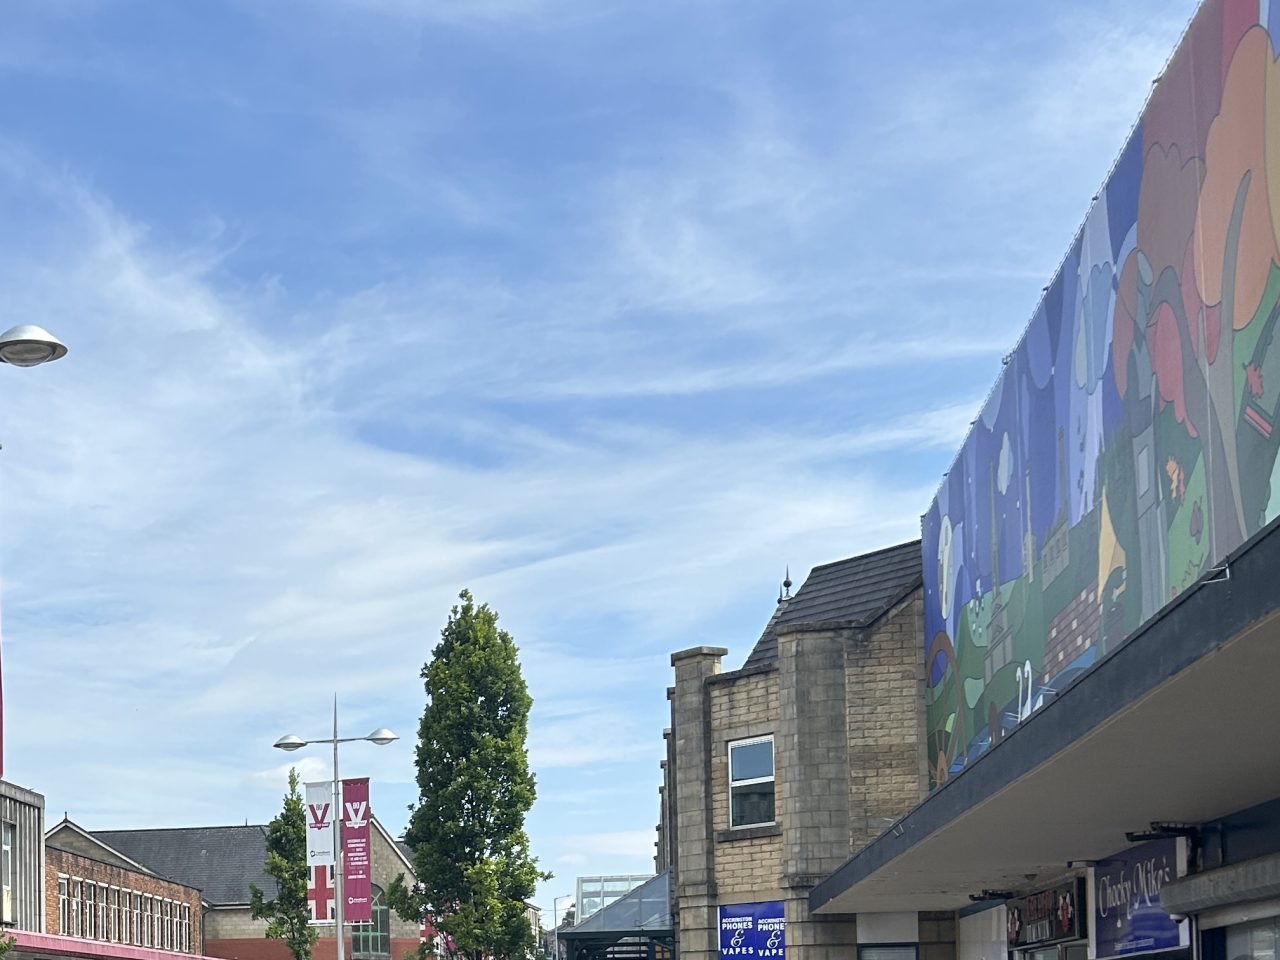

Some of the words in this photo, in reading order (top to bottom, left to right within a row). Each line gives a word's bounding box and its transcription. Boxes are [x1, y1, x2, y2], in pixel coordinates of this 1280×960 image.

[721, 922, 753, 931] PHONES
[757, 922, 788, 932] PHONE
[730, 929, 745, 948] &
[766, 930, 782, 949] &
[721, 946, 754, 955] VAPES
